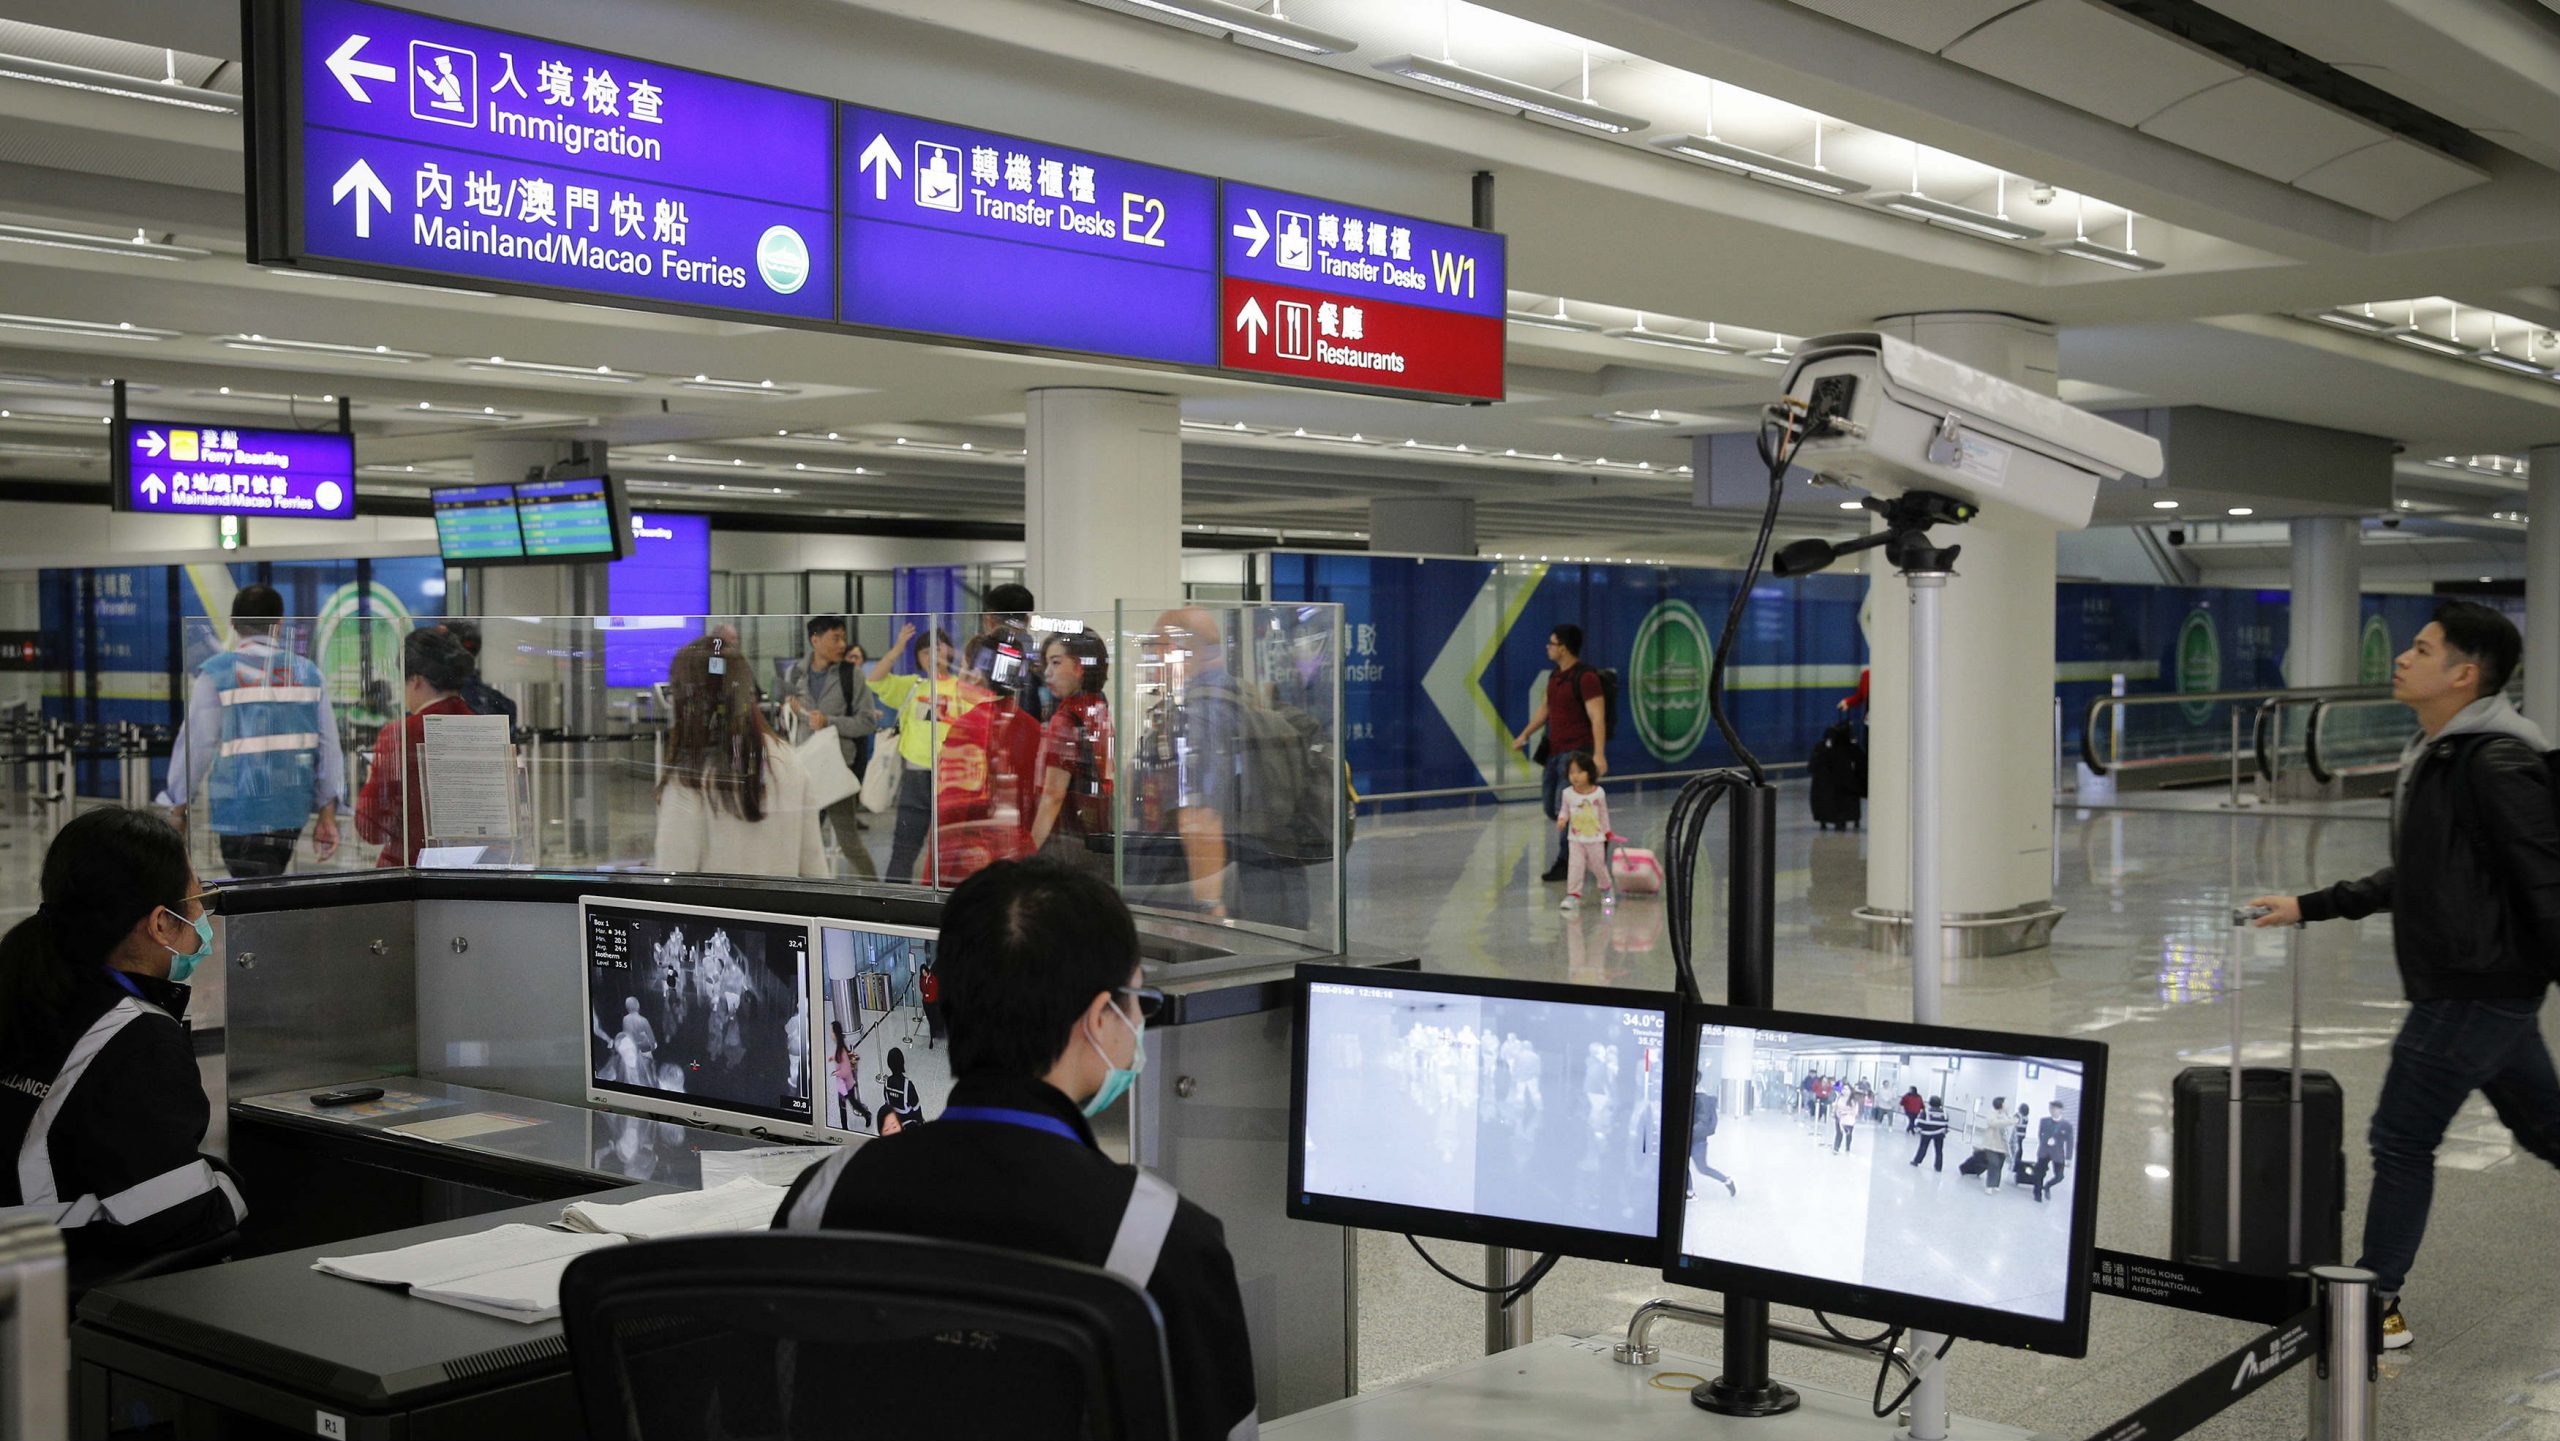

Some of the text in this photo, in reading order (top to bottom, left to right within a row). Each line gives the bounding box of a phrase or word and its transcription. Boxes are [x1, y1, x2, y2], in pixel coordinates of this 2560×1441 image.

[489, 52, 664, 125] 入境檢查
[490, 101, 661, 161] Immigration
[415, 162, 688, 247] 內地/澳門快船
[970, 188, 1166, 248] Transfer Desks E2
[413, 213, 747, 290] Mainland/Macao Ferries
[1317, 249, 1476, 300] Transfer Desks W1
[1316, 301, 1364, 340] 餐廳
[1316, 340, 1406, 373] Restaurants
[200, 448, 290, 469] Ferry Boarding
[171, 491, 314, 511] Mainland/Macao Ferries
[788, 940, 802, 948] 32.4
[595, 951, 620, 959] Isotherm
[793, 1100, 807, 1108] 20.8
[2101, 1260, 2125, 1277] 香港
[2131, 1265, 2185, 1282] HONG KONG
[2131, 1275, 2203, 1295] INTERNATIONAL
[2131, 1285, 2170, 1298] AIRPORT
[324, 1418, 338, 1434] R1
